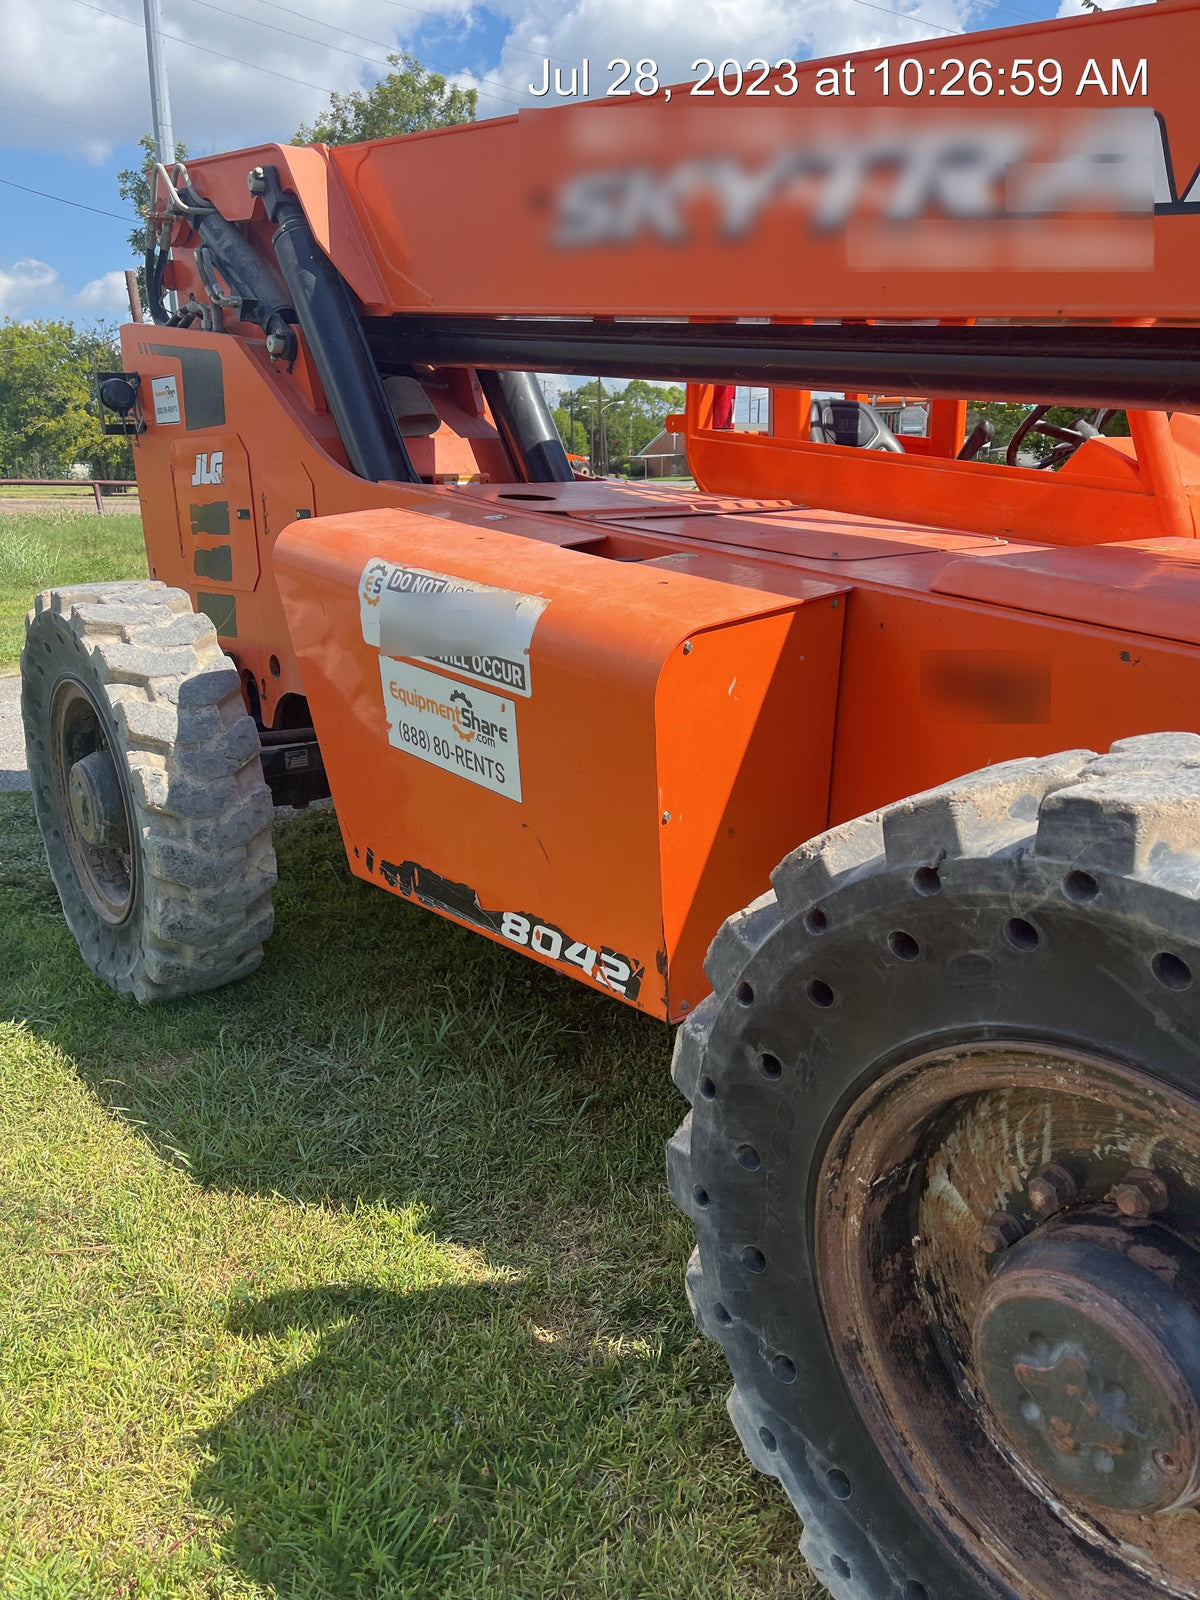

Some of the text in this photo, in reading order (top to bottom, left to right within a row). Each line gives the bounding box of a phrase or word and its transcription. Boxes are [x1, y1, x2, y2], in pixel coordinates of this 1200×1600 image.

[191, 450, 225, 487] JLG
[390, 571, 412, 590] DO
[411, 576, 445, 593] NOT
[439, 656, 522, 687] LL OCCUR
[398, 720, 505, 783] (888) 80-RENTS
[475, 733, 496, 748] .com
[501, 911, 630, 994] 8042
